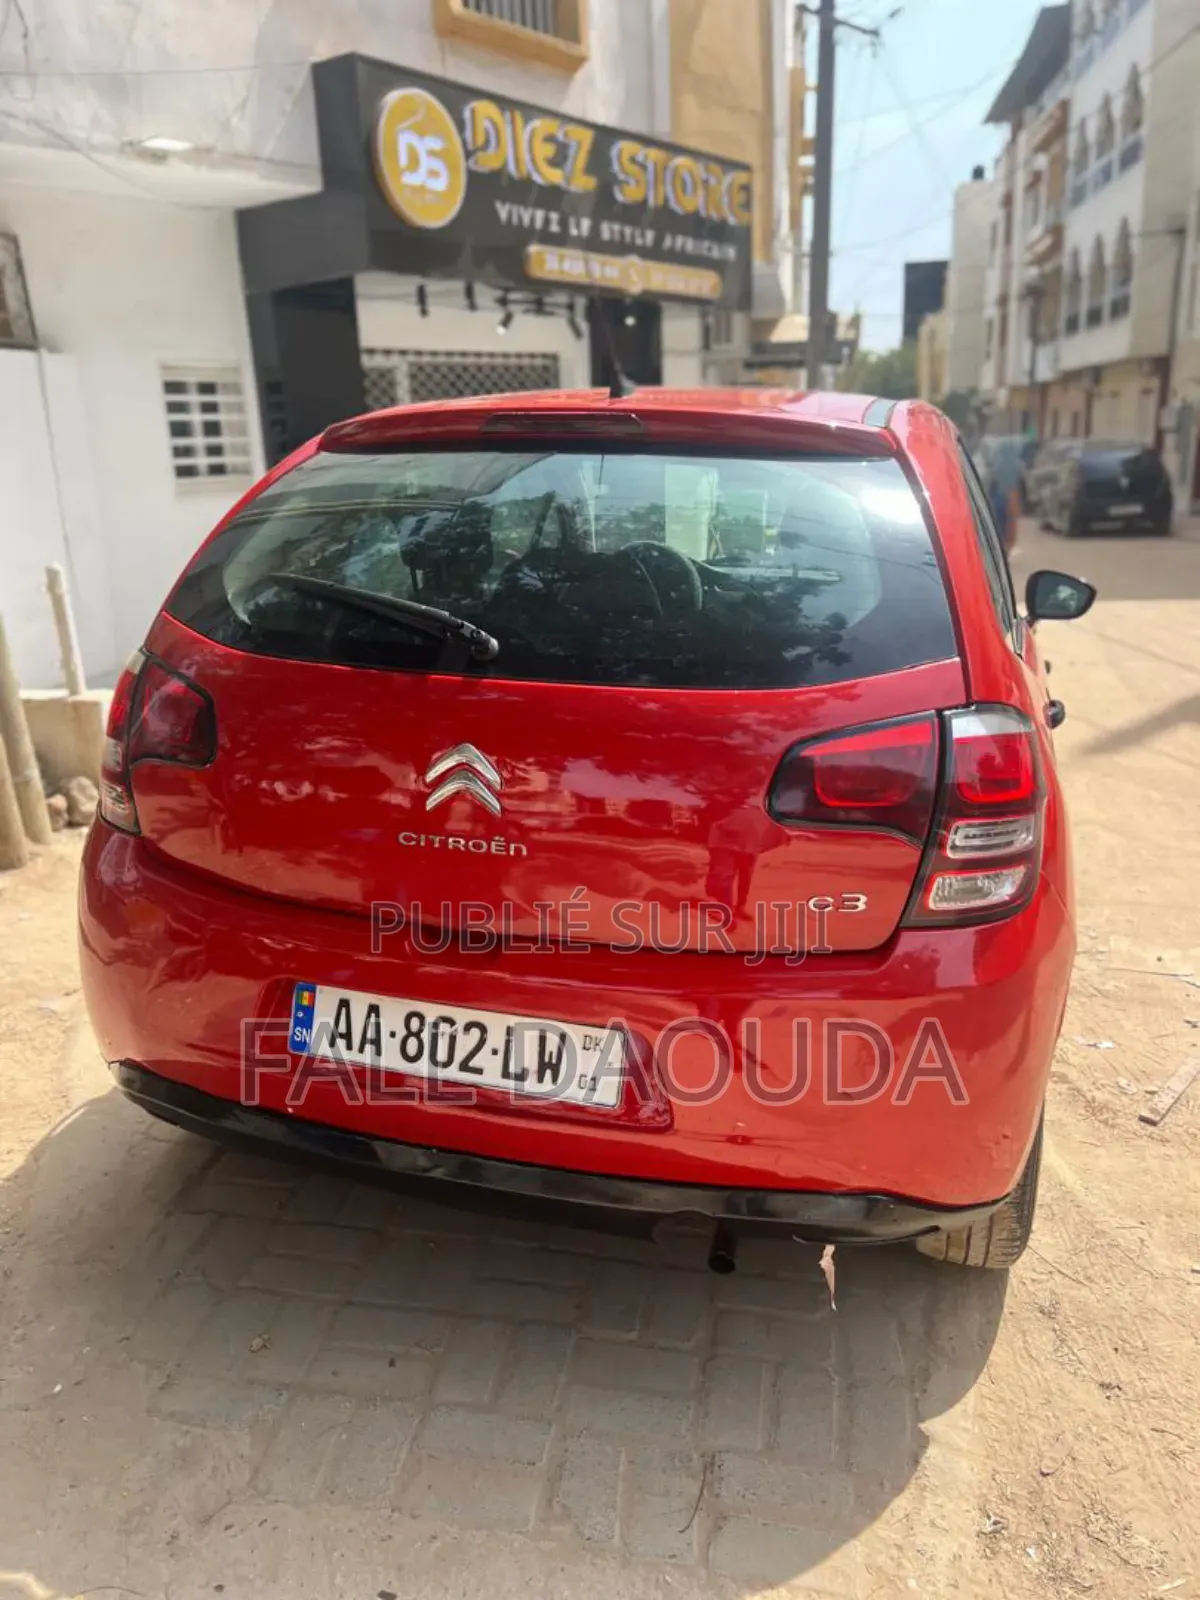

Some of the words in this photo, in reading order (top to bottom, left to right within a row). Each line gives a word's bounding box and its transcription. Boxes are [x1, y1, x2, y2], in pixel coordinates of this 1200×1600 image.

[397, 130, 449, 191] DS
[464, 99, 597, 192] DIEZ
[610, 140, 753, 226] STORE
[807, 892, 868, 913] C3
[294, 1026, 312, 1043] SN
[582, 1033, 605, 1053] DK
